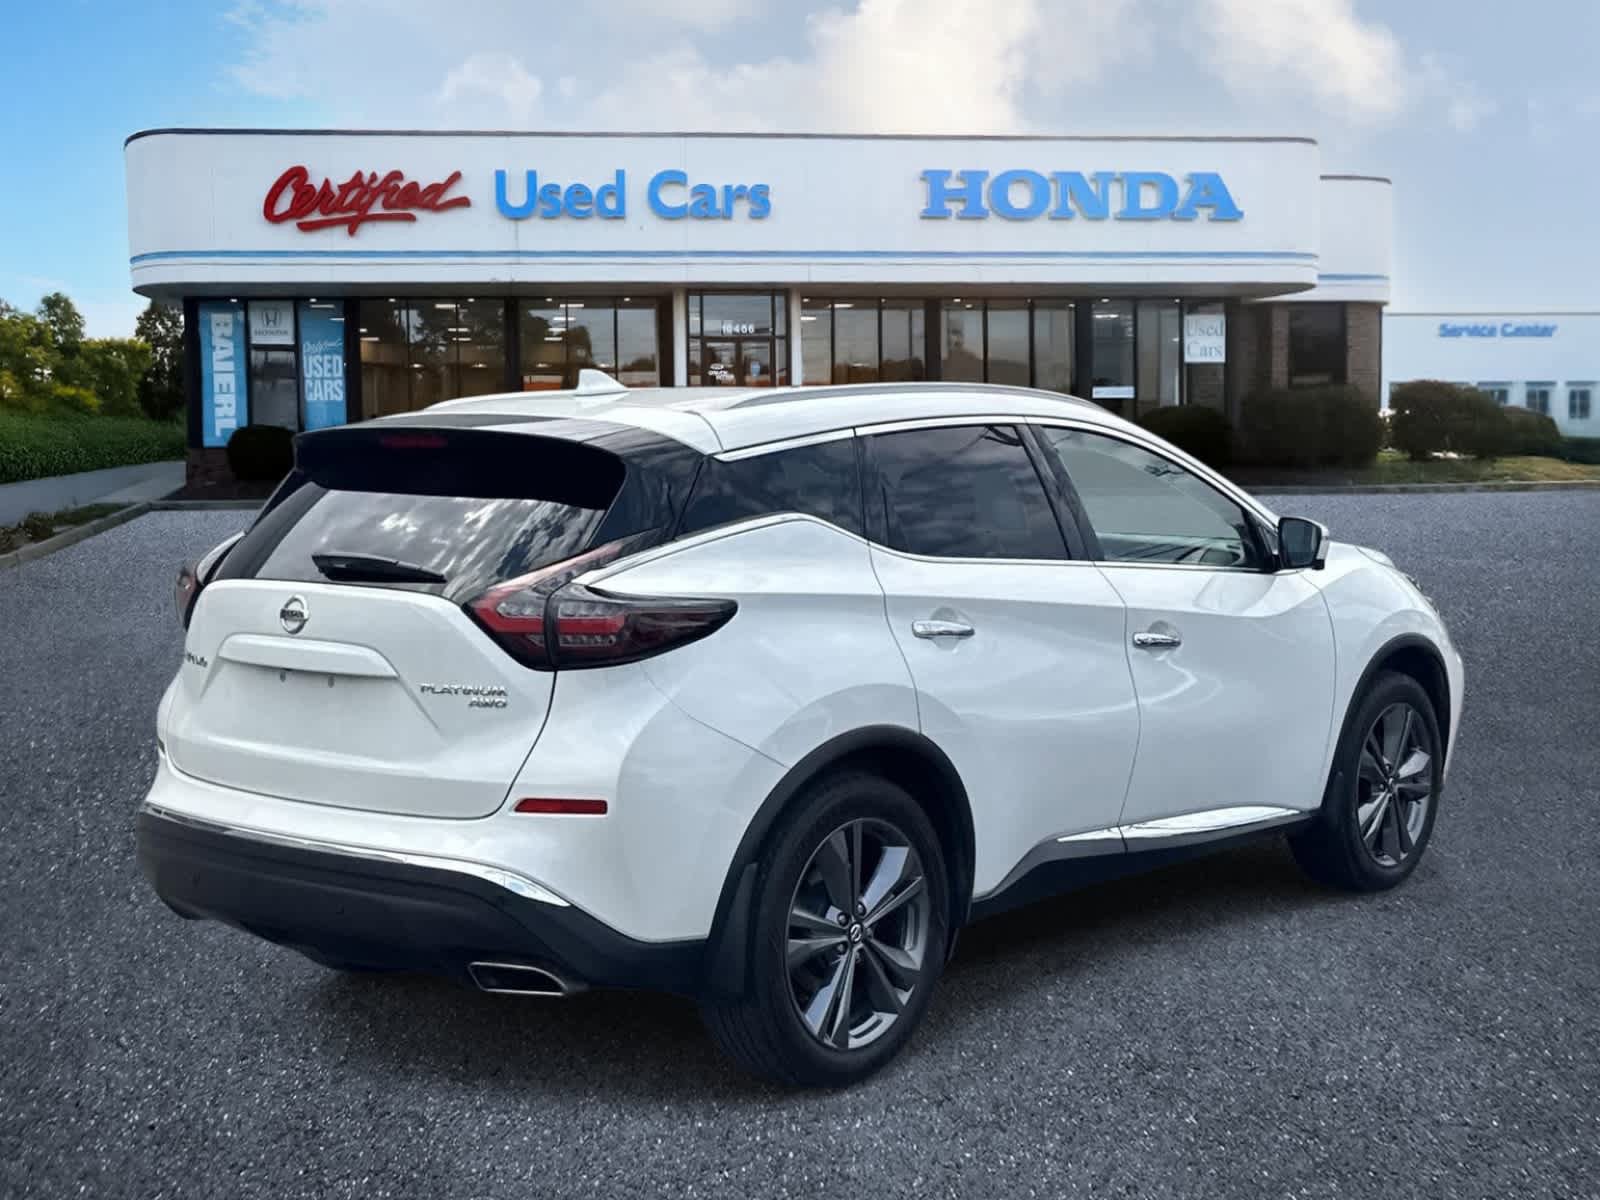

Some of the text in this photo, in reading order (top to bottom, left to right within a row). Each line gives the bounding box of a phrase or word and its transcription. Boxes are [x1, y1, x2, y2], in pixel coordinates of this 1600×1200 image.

[263, 165, 772, 237] Certified Used Cars
[919, 168, 1245, 222] HONDA
[1186, 318, 1224, 337] Used
[1186, 340, 1223, 358] Cars
[211, 313, 236, 438] BAIERL
[303, 354, 343, 378] USED
[304, 378, 345, 402] CARS
[420, 683, 508, 697] PLATINUM
